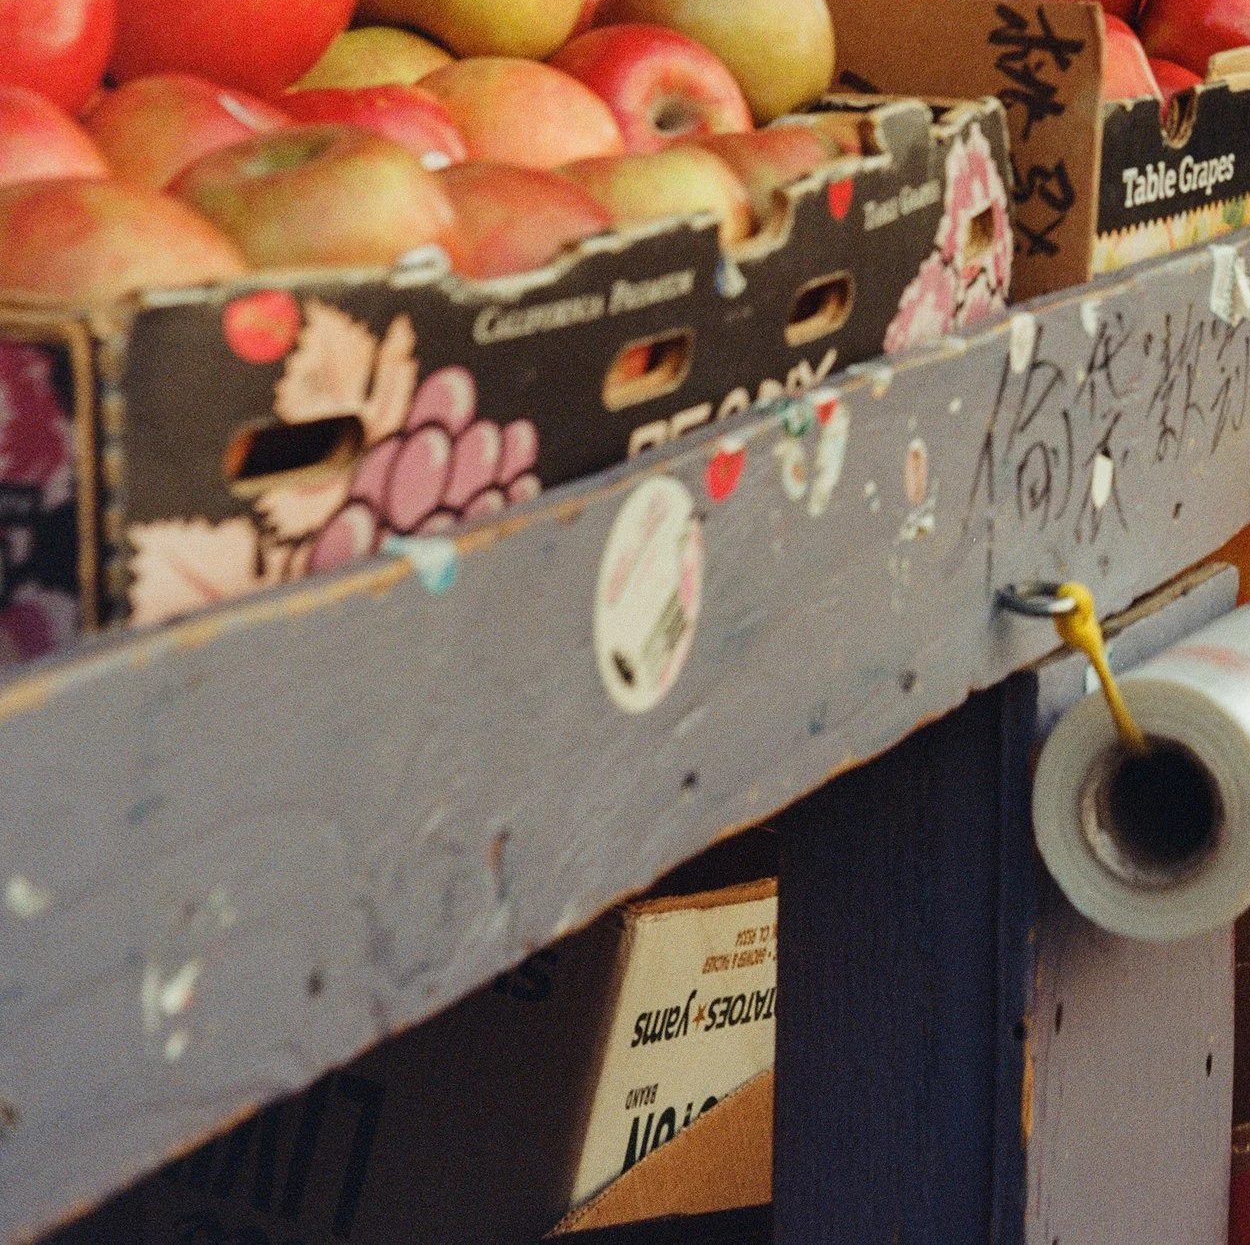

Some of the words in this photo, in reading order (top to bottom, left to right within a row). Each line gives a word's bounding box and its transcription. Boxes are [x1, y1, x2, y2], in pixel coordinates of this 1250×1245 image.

[1122, 160, 1178, 209] Table
[1178, 152, 1236, 196] Grapes
[630, 989, 698, 1048] yams
[703, 986, 779, 1032] TATOES
[625, 1083, 659, 1110] BRAND
